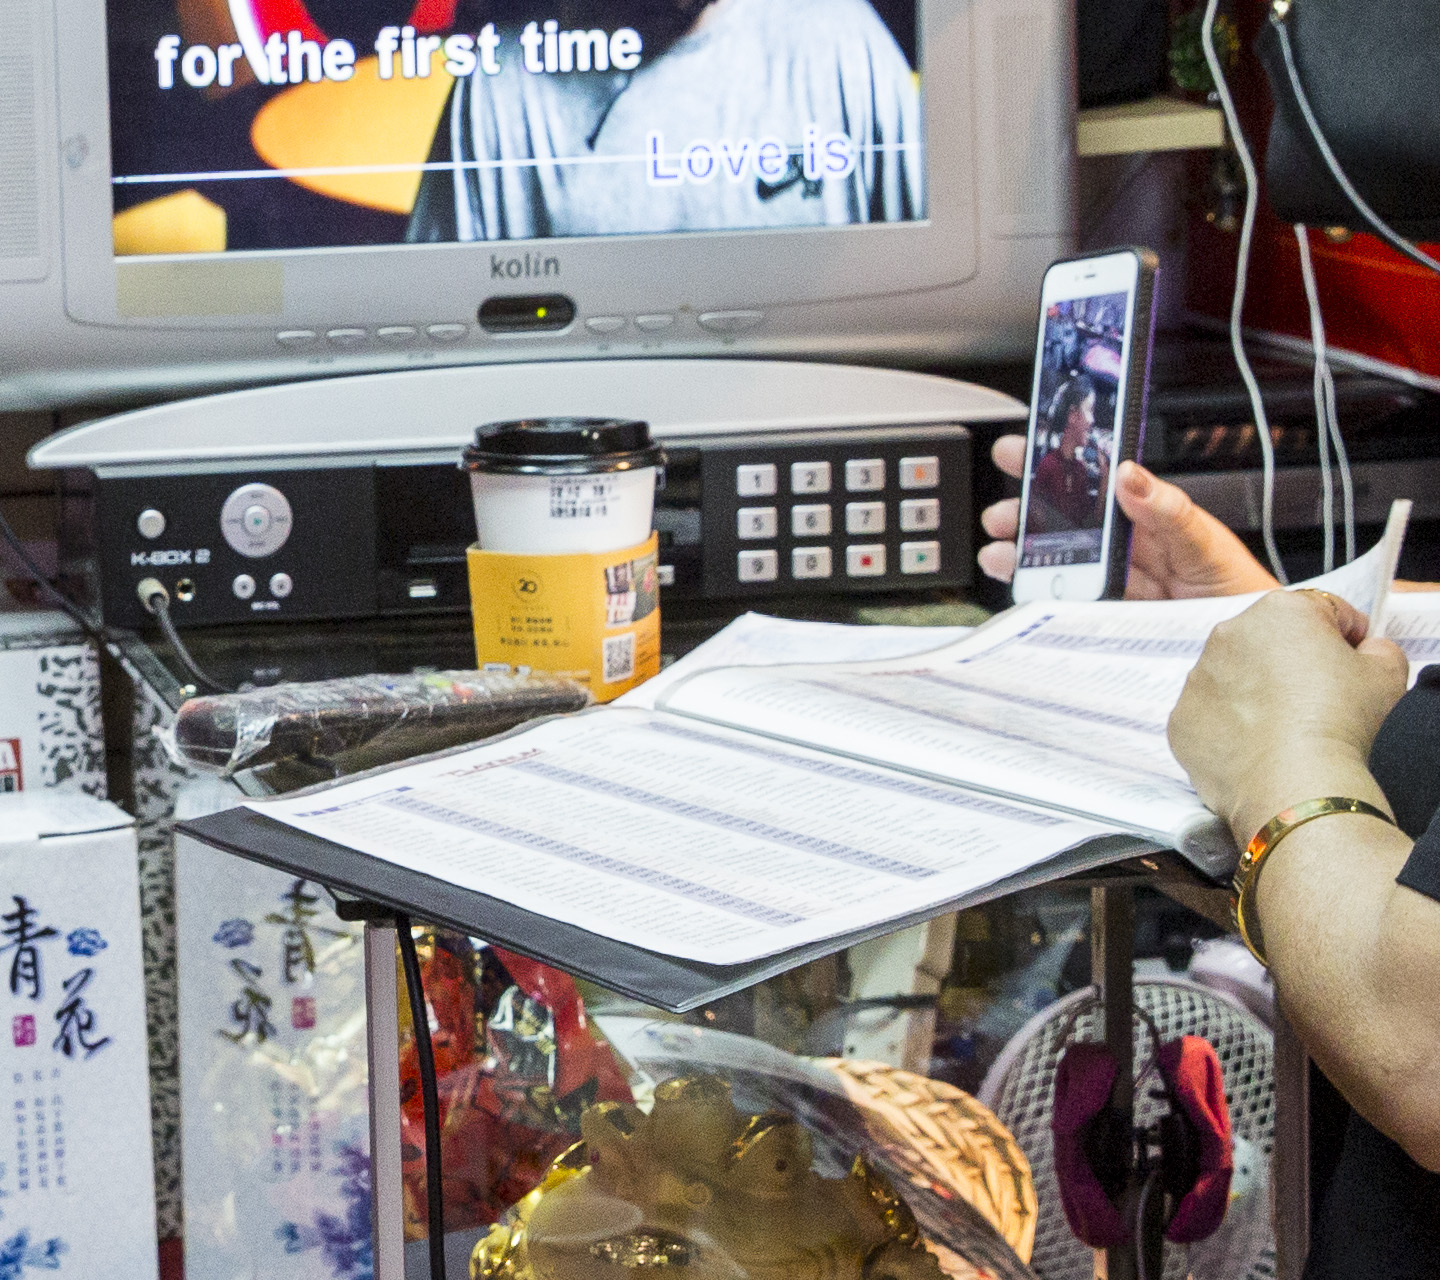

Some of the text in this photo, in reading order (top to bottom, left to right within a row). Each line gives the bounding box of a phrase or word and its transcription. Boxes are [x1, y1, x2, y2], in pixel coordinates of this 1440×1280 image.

[154, 20, 643, 89] for the first time
[649, 126, 853, 182] Love is
[490, 252, 560, 279] kolin
